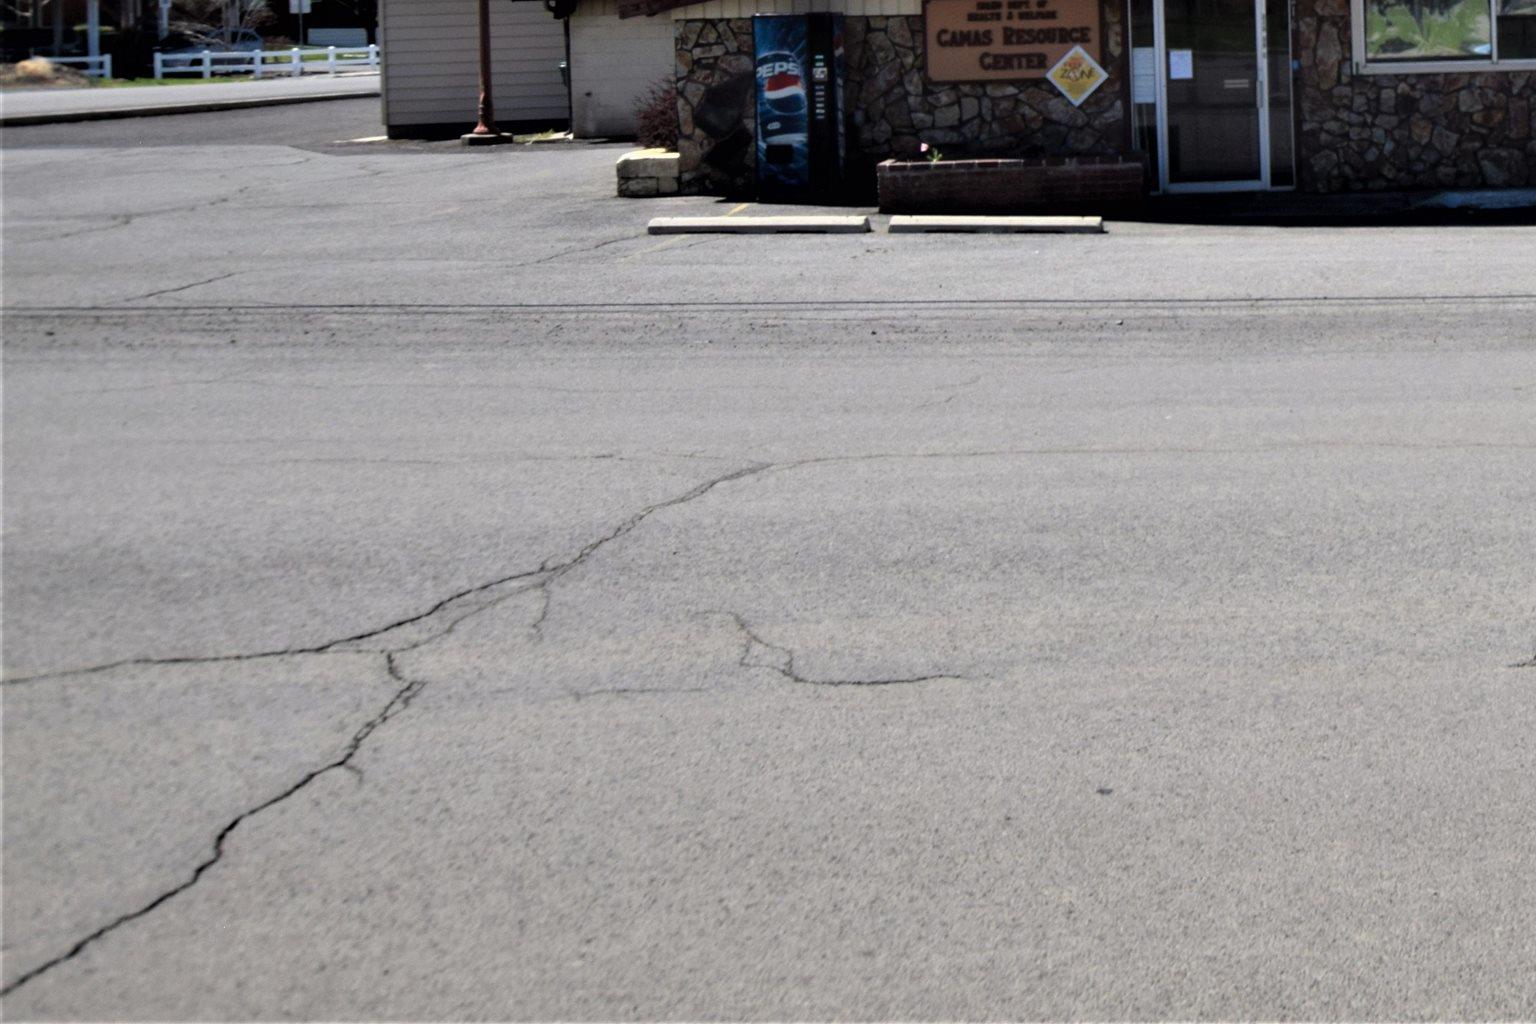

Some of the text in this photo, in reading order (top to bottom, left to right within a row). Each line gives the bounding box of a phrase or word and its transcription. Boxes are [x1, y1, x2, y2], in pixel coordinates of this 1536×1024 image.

[936, 26, 1091, 47] CAMAS RESOURCE
[979, 52, 1048, 71] CENTER
